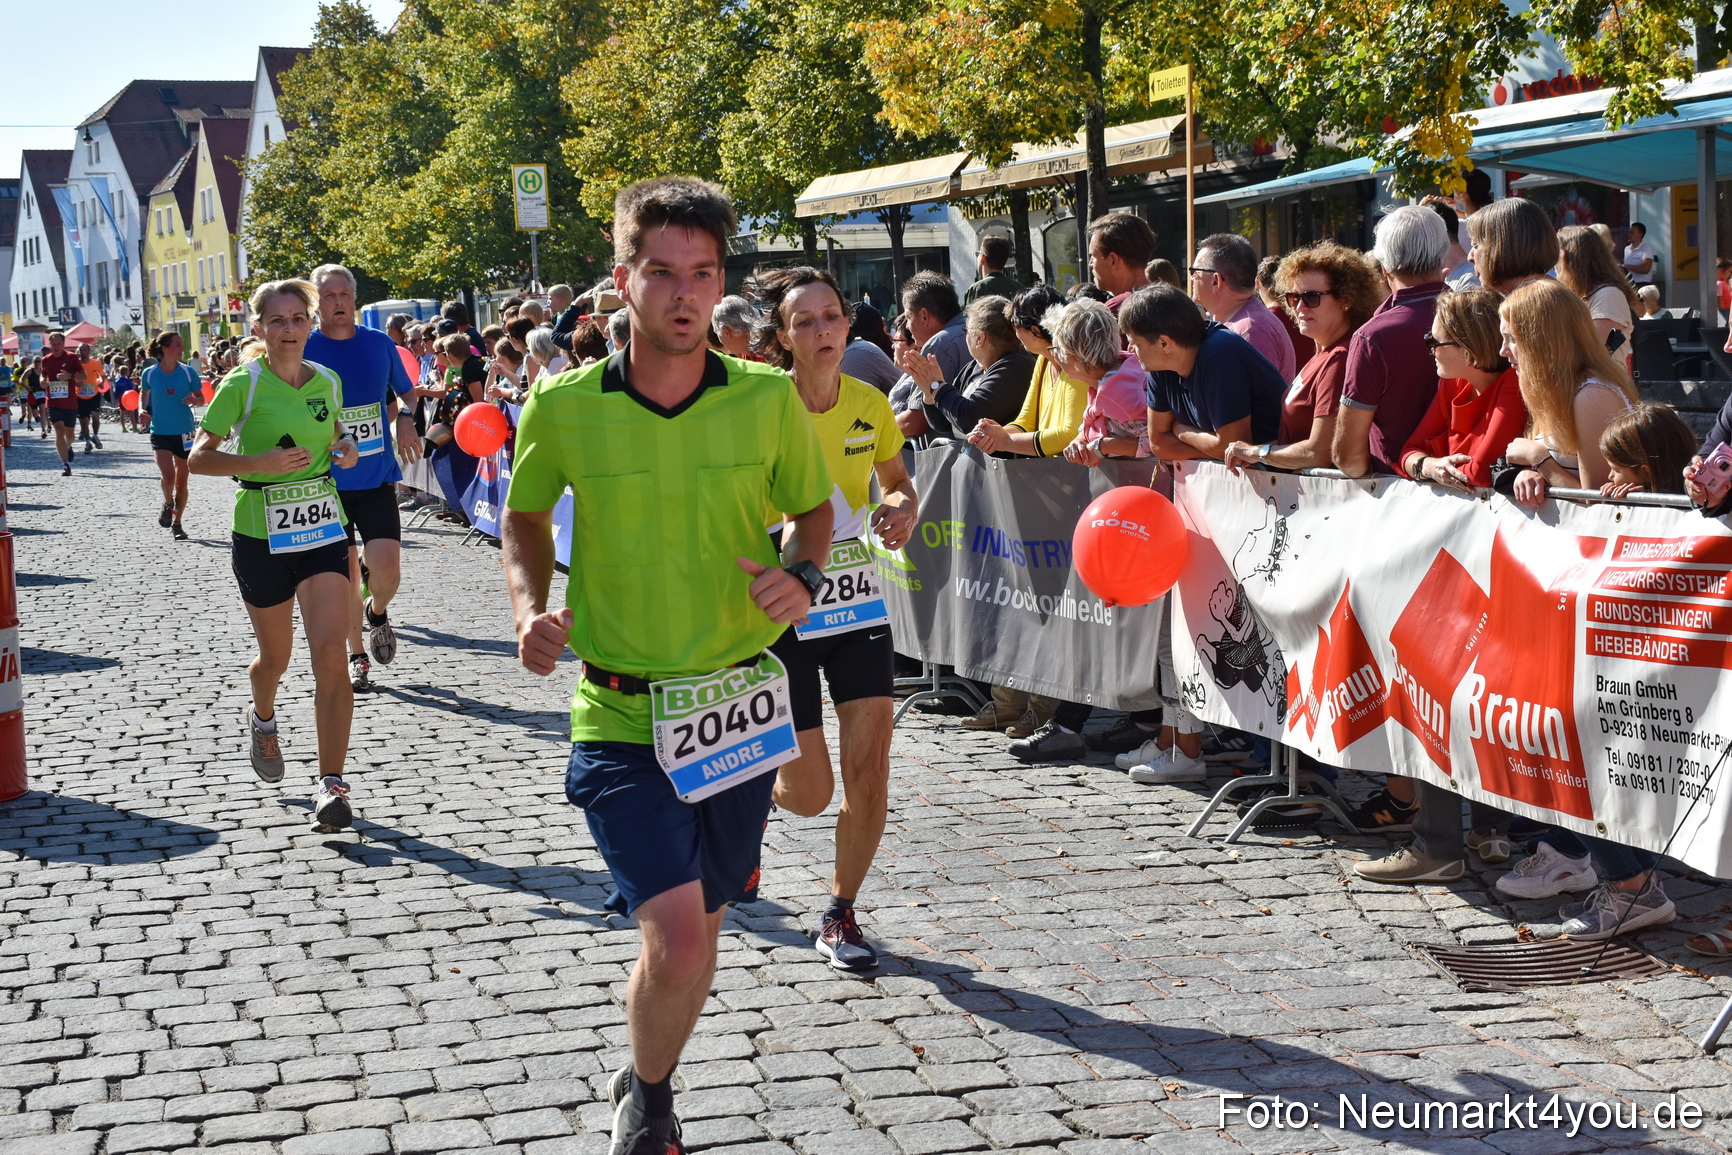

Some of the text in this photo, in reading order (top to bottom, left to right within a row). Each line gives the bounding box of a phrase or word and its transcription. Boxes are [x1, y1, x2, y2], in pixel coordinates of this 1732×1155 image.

[1157, 76, 1187, 92] Toiletten
[348, 421, 379, 443] 791
[845, 443, 875, 457] Runners
[270, 482, 329, 504] BOCK
[275, 501, 332, 530] 2484
[1091, 509, 1151, 537] RÖDL
[291, 528, 325, 545] HEIKE
[1119, 528, 1149, 542] energie
[1620, 540, 1697, 559] BINDESTRICKE
[811, 571, 871, 607] 284
[1602, 569, 1728, 595] VERZURRSYSTEME
[824, 610, 857, 626] RITA
[1594, 600, 1713, 630] RUNDSCHLINGEN
[1465, 612, 1489, 651] Seit 1929
[1594, 634, 1690, 662] HEBEBÄNDER
[662, 666, 779, 717] BOCK
[1326, 663, 1382, 724] Braun
[1391, 645, 1445, 739] Braun
[1596, 674, 1678, 701] Braun GmbH
[672, 689, 776, 760] 2040
[1348, 707, 1369, 724] Sicher
[1369, 701, 1378, 712] ist
[1454, 668, 1570, 763] Braun
[1597, 696, 1694, 727] Am Grünberg 8
[1600, 717, 1647, 741] D-92318
[701, 740, 766, 781] ANDRE
[1508, 756, 1588, 789] Sicher ist sicher
[1605, 746, 1625, 767] Tel.
[1627, 751, 1663, 773] 09181
[1676, 757, 1712, 781] 2307-0
[1608, 768, 1628, 788] Fax
[1630, 773, 1666, 795] 09181
[1678, 780, 1714, 807] 2307-70
